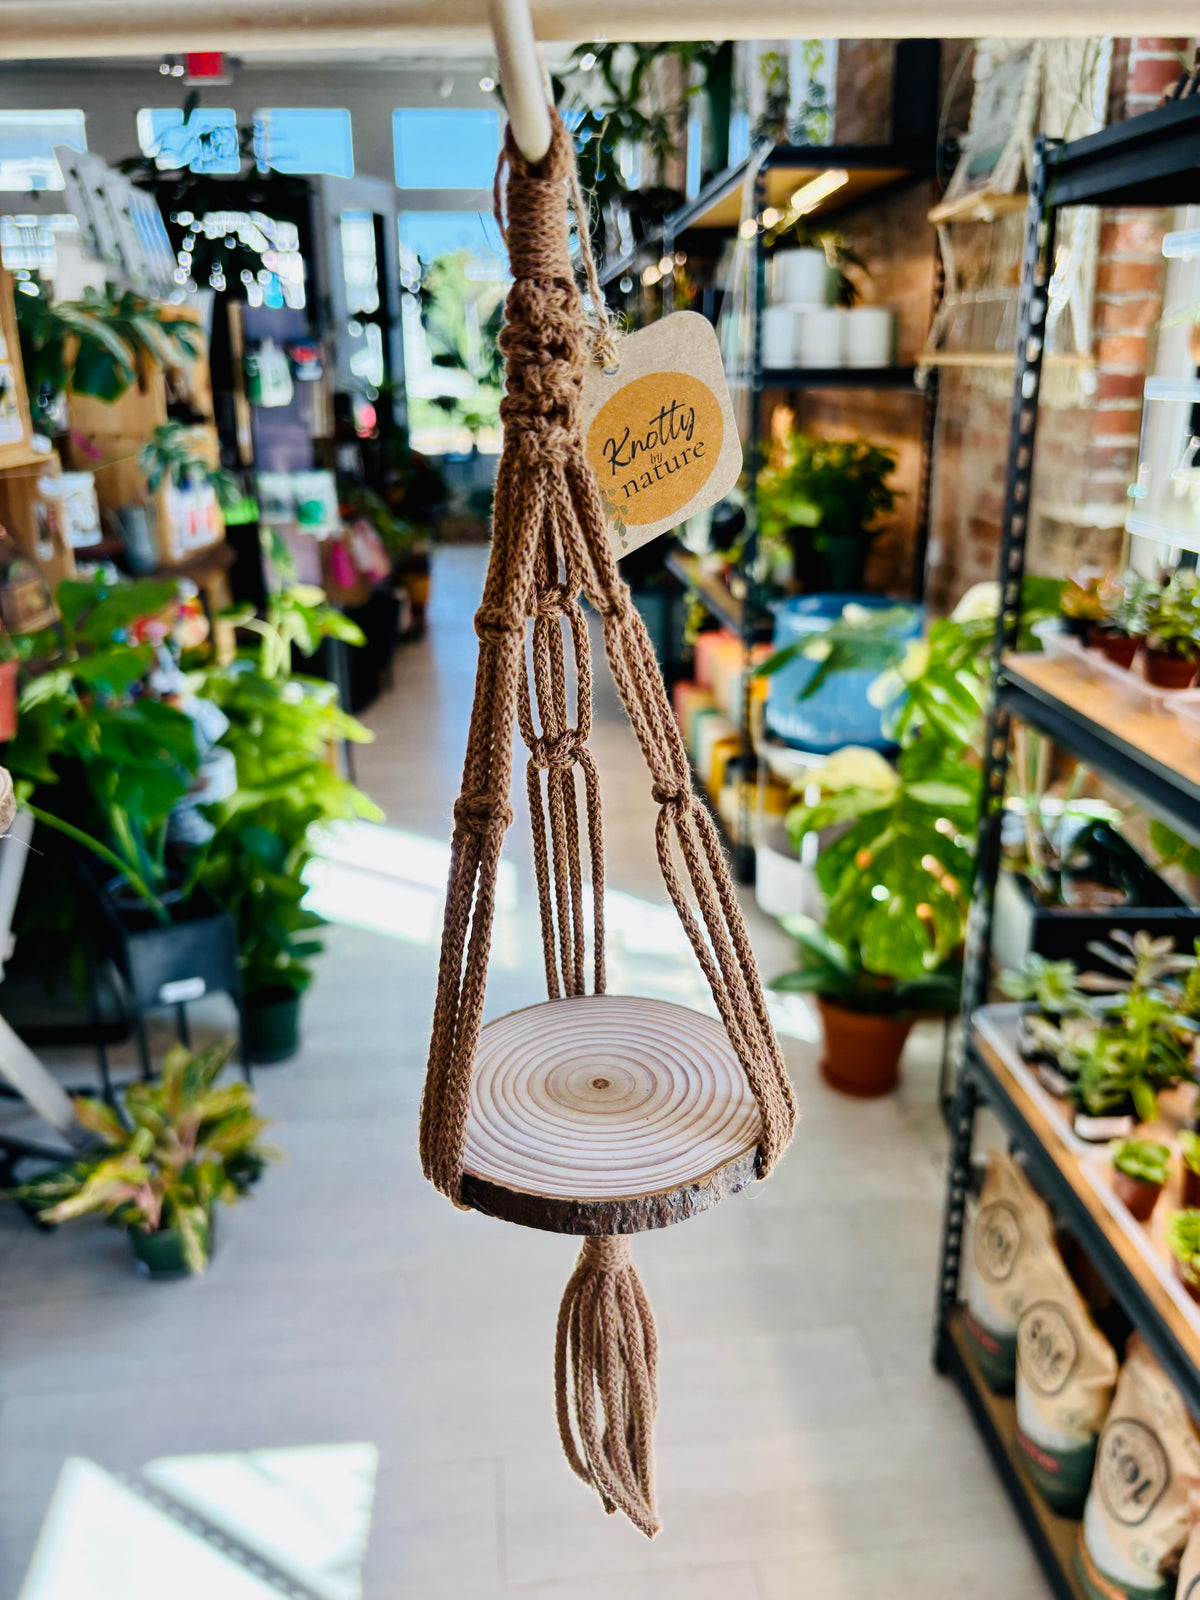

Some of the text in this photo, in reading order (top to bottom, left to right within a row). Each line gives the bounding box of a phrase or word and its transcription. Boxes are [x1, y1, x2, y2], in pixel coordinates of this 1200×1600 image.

[602, 399, 695, 476] Knotty
[650, 452, 663, 464] by
[621, 441, 706, 498] nature
